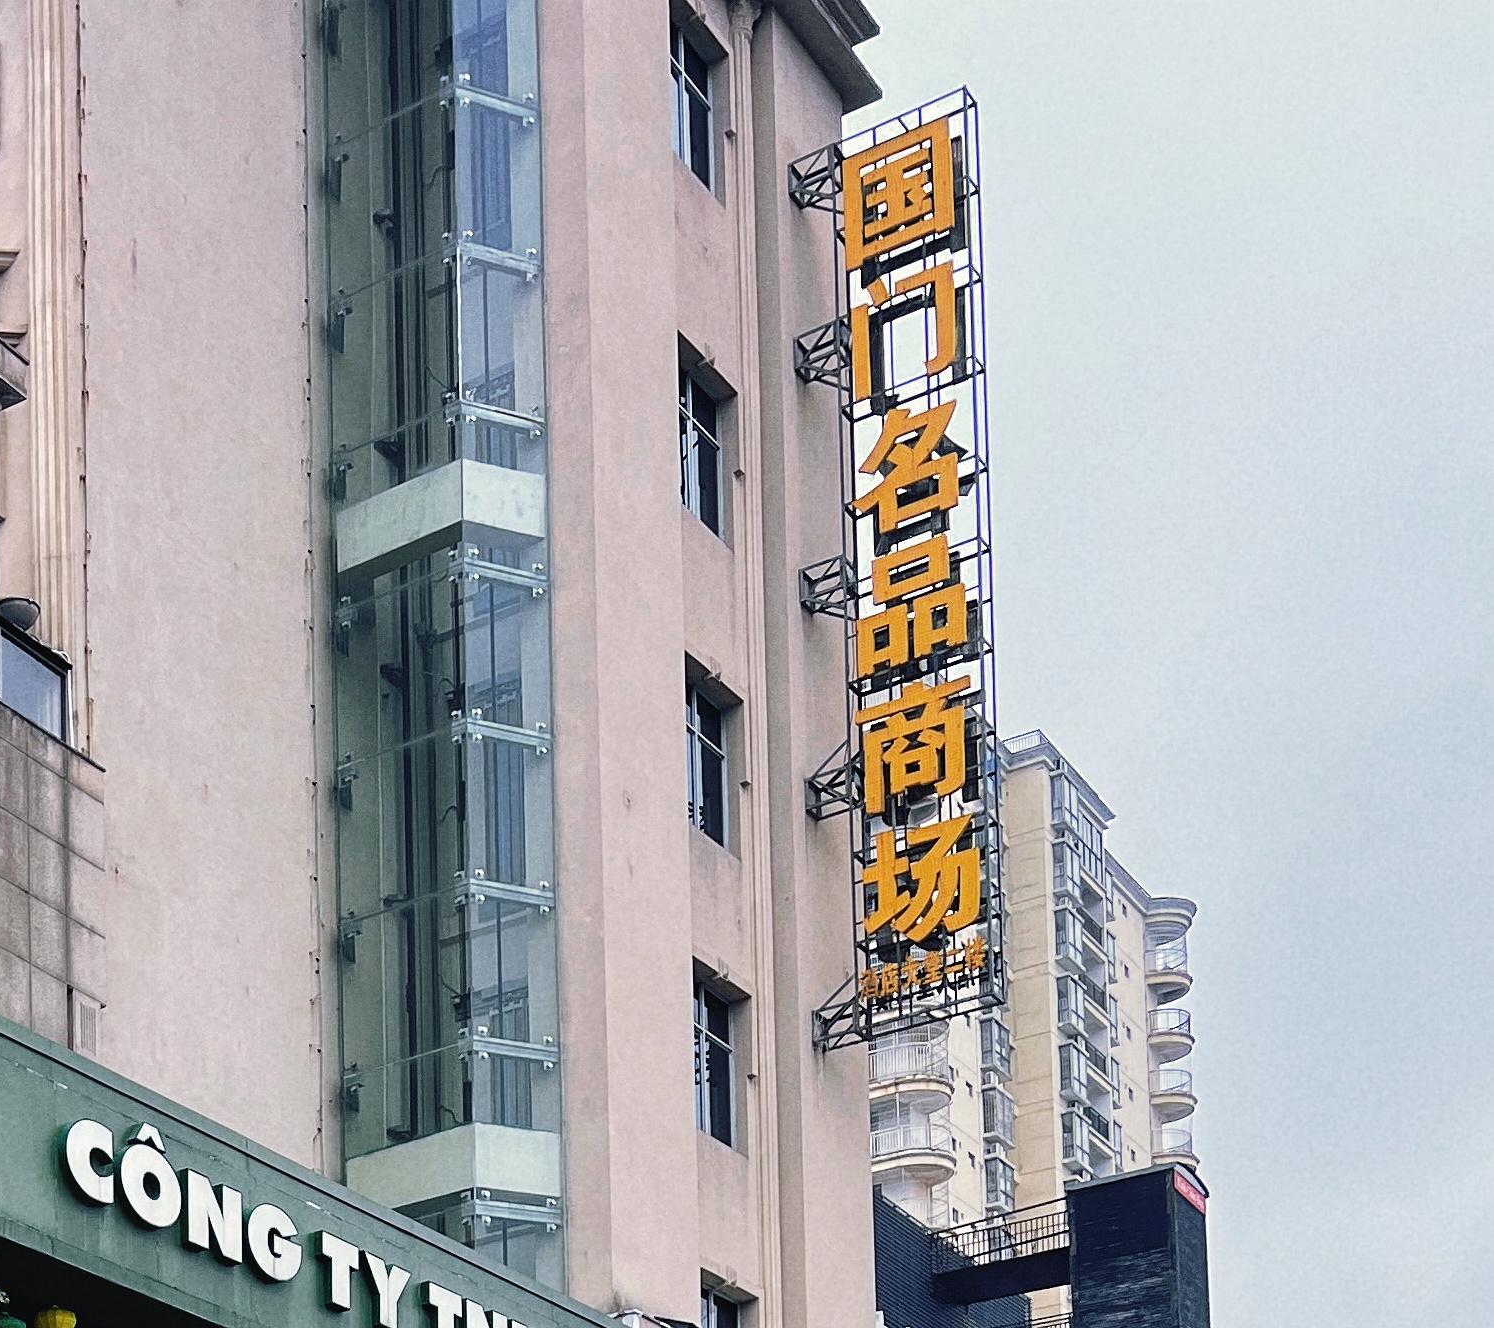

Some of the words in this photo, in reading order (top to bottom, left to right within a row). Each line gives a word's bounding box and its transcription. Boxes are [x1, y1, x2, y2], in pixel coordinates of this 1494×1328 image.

[840, 115, 982, 946] 国门名品商场
[64, 1119, 303, 1283] CÔNG
